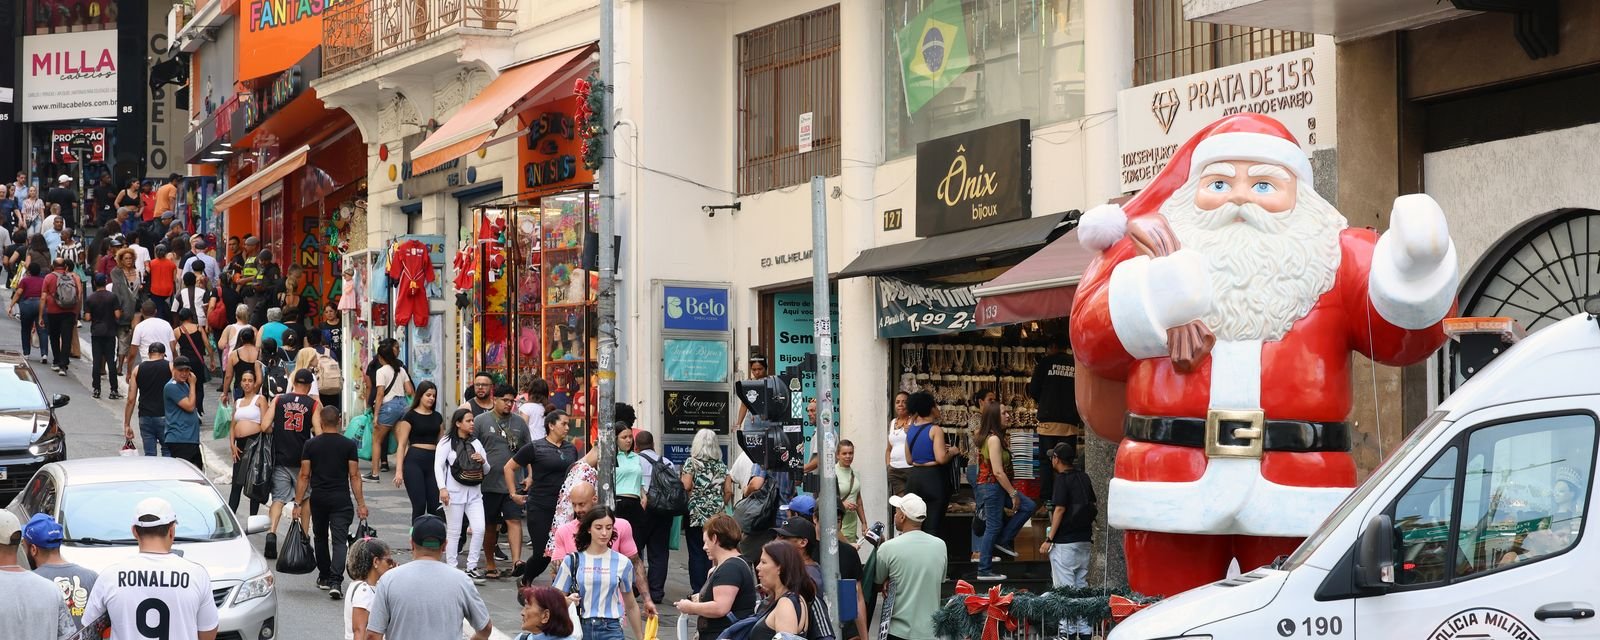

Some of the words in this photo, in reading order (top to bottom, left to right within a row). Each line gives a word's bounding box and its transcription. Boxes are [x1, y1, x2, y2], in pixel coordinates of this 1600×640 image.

[32, 49, 116, 76] MILLA
[60, 65, 117, 81] cabelos
[1187, 73, 1247, 112] PRATA
[1249, 65, 1275, 99] DE
[1277, 59, 1300, 93] 15
[32, 99, 118, 111] www.millacabelos.com.br
[150, 33, 168, 170] CBELO
[1277, 90, 1313, 110] VAREJO
[937, 143, 998, 207] Ônix
[884, 210, 901, 230] 127
[972, 203, 998, 221] bijoux
[685, 296, 726, 317] Belo
[783, 308, 799, 316] Aqui
[984, 304, 998, 319] 133
[907, 311, 946, 332] 1,99
[946, 311, 976, 330] 2,
[682, 395, 726, 412] Elegancy
[284, 411, 304, 432] 23
[671, 445, 684, 453] Vila
[118, 570, 190, 588] RONALDO
[136, 597, 170, 640] 9
[1302, 616, 1343, 636] 190
